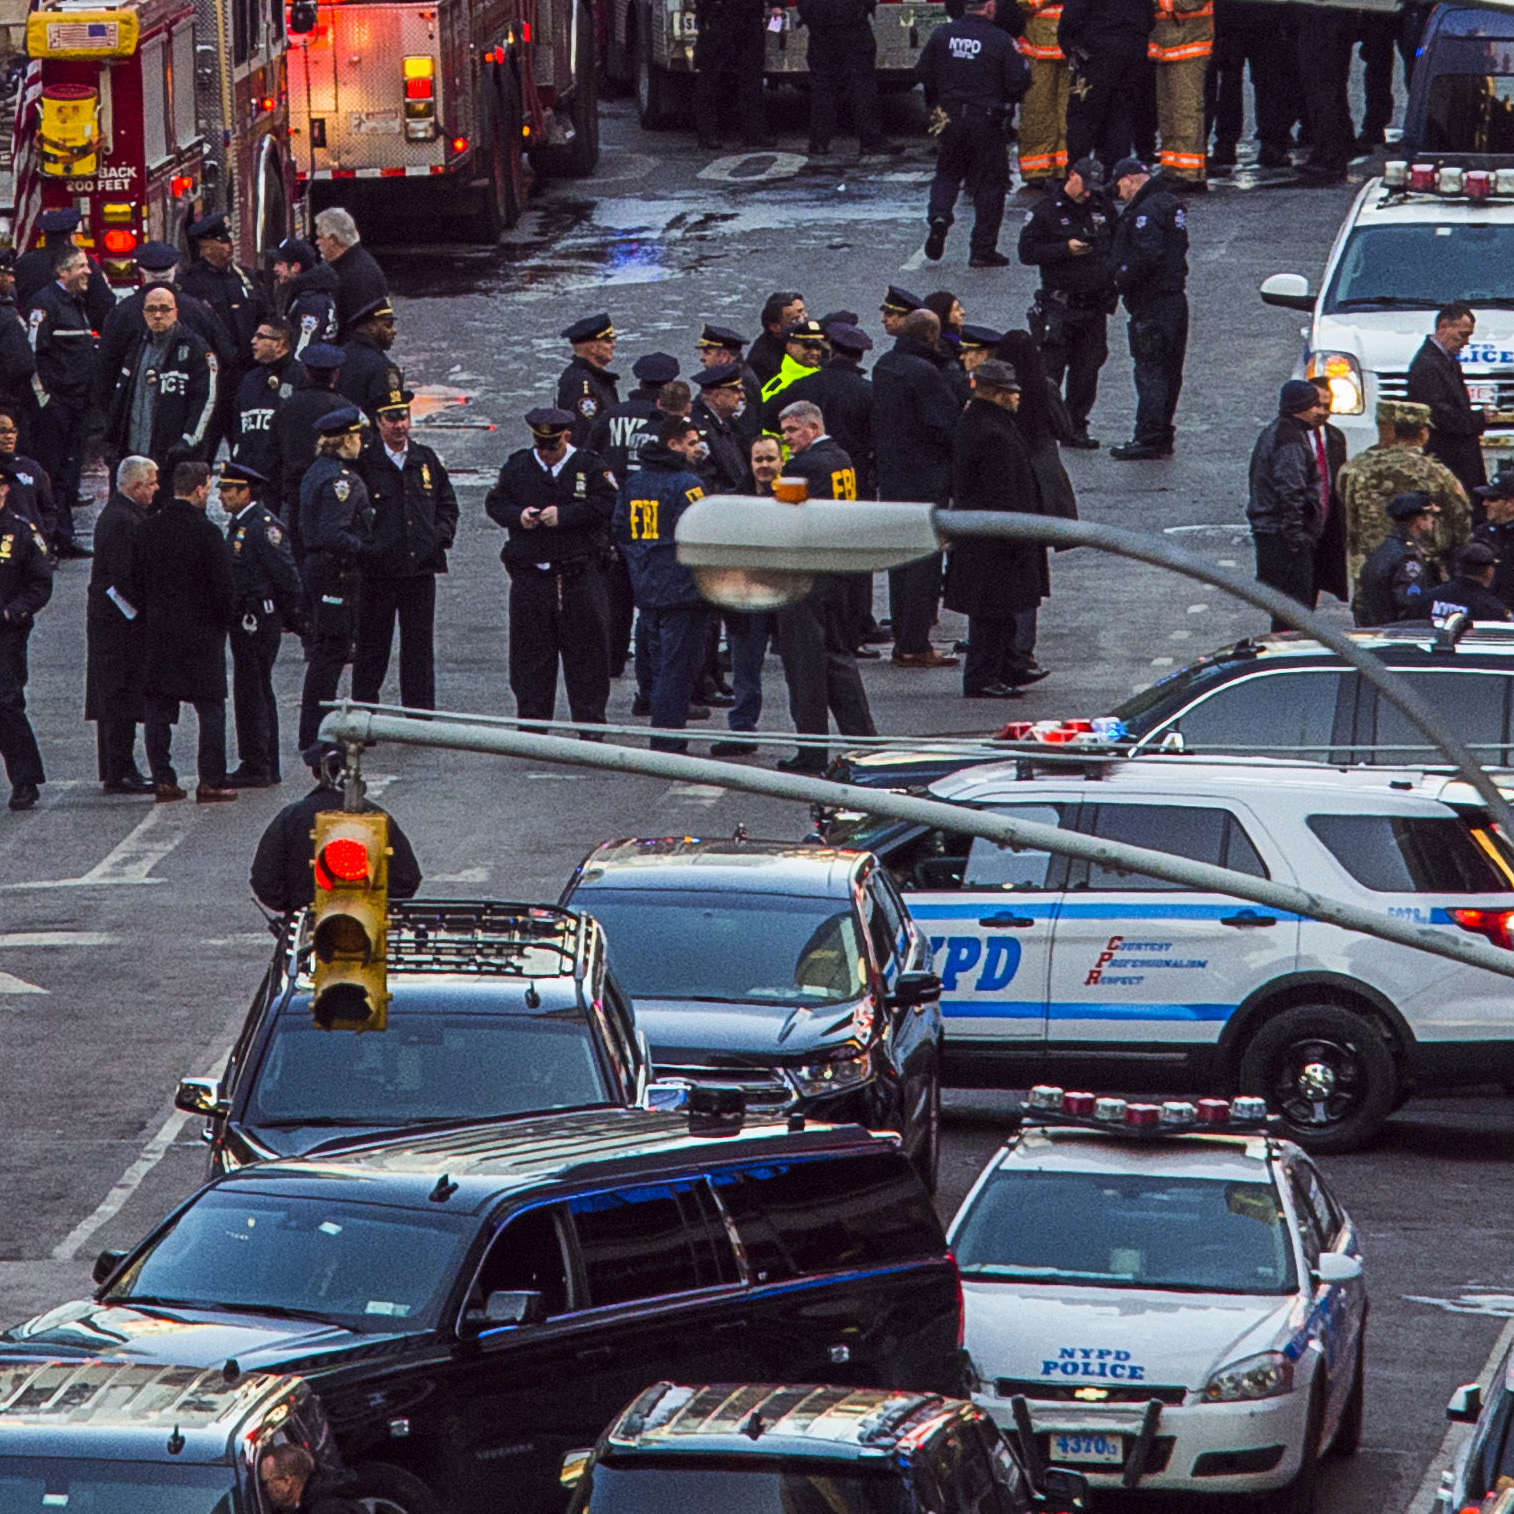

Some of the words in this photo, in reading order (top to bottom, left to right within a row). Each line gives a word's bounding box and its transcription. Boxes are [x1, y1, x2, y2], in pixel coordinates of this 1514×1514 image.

[949, 35, 982, 54] NYPD
[97, 165, 138, 181] BACK
[66, 179, 94, 194] 200
[95, 178, 131, 192] FEET
[1459, 350, 1514, 364] LICE
[629, 499, 660, 540] FBI
[930, 936, 1023, 992] YPD
[1058, 1347, 1132, 1362] NYPD
[1040, 1359, 1146, 1381] POLICE
